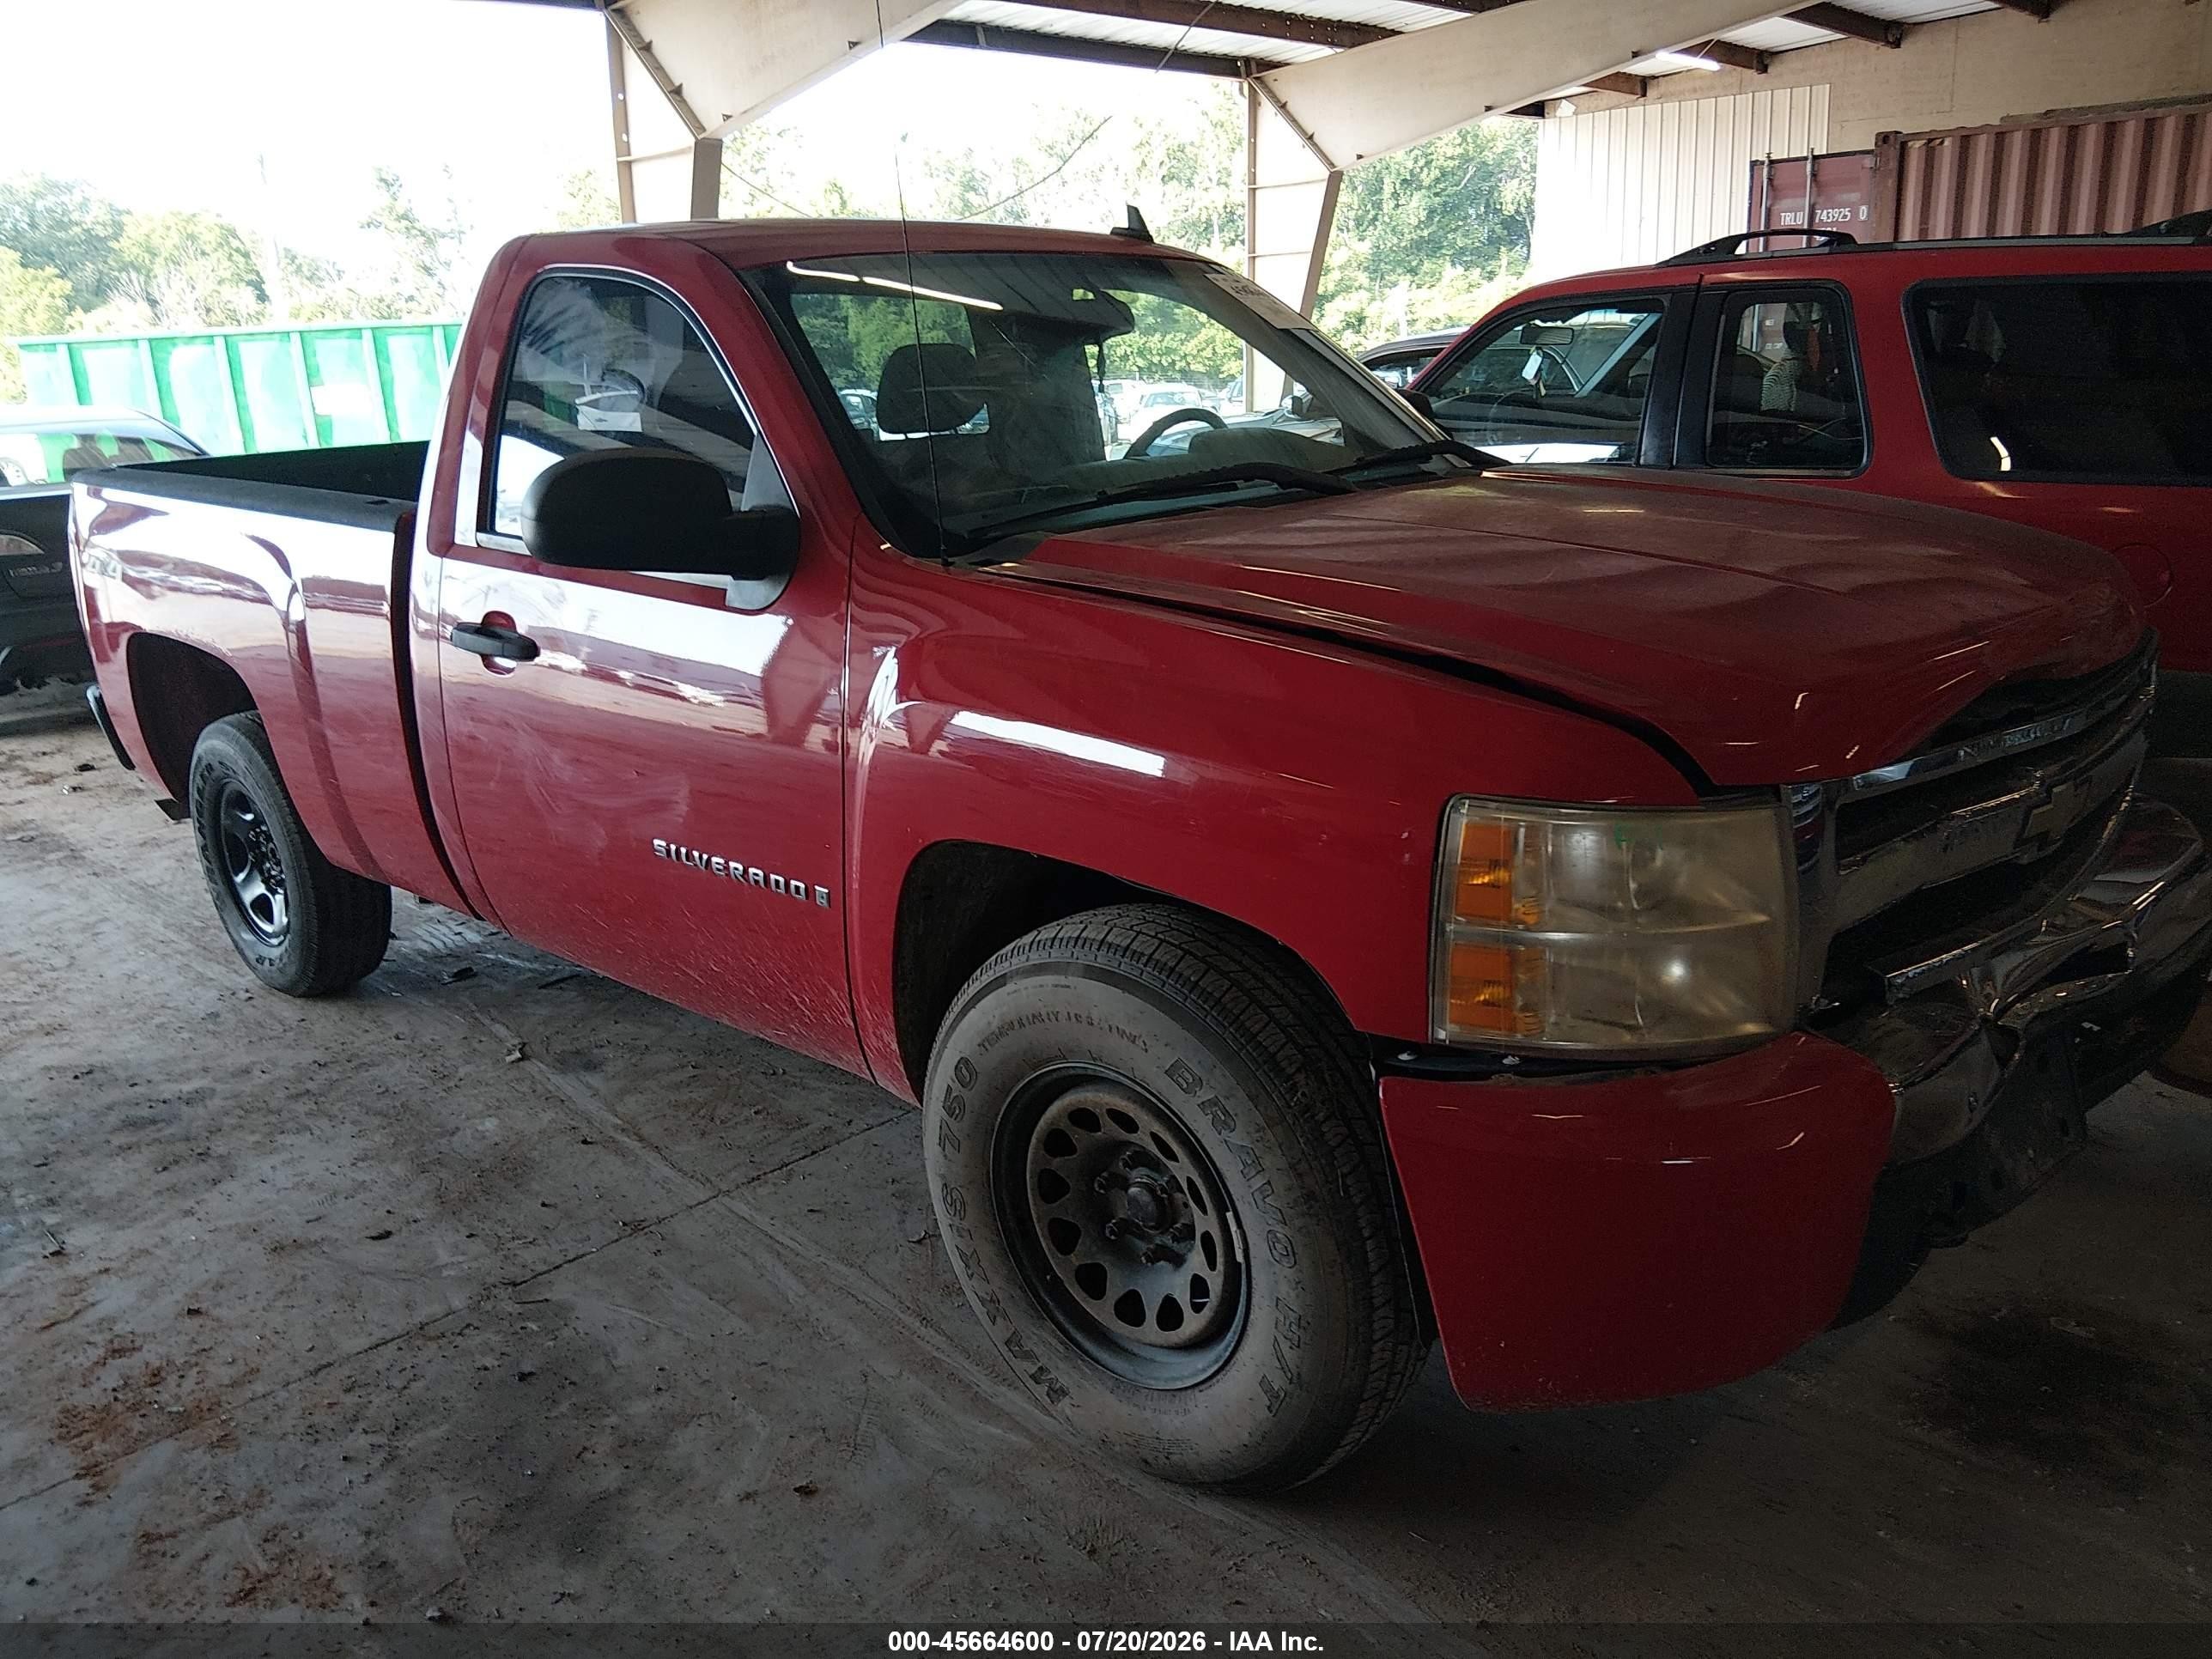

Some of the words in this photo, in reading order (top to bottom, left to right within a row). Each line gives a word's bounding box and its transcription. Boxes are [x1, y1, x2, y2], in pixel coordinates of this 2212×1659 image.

[1780, 211, 1804, 226] TRLU
[1814, 208, 1851, 223] 743925
[653, 838, 810, 901] SILVERADO
[938, 1056, 978, 1154] 750
[1164, 1057, 1297, 1269] BRAVO
[941, 1182, 1073, 1407] MAXXIS
